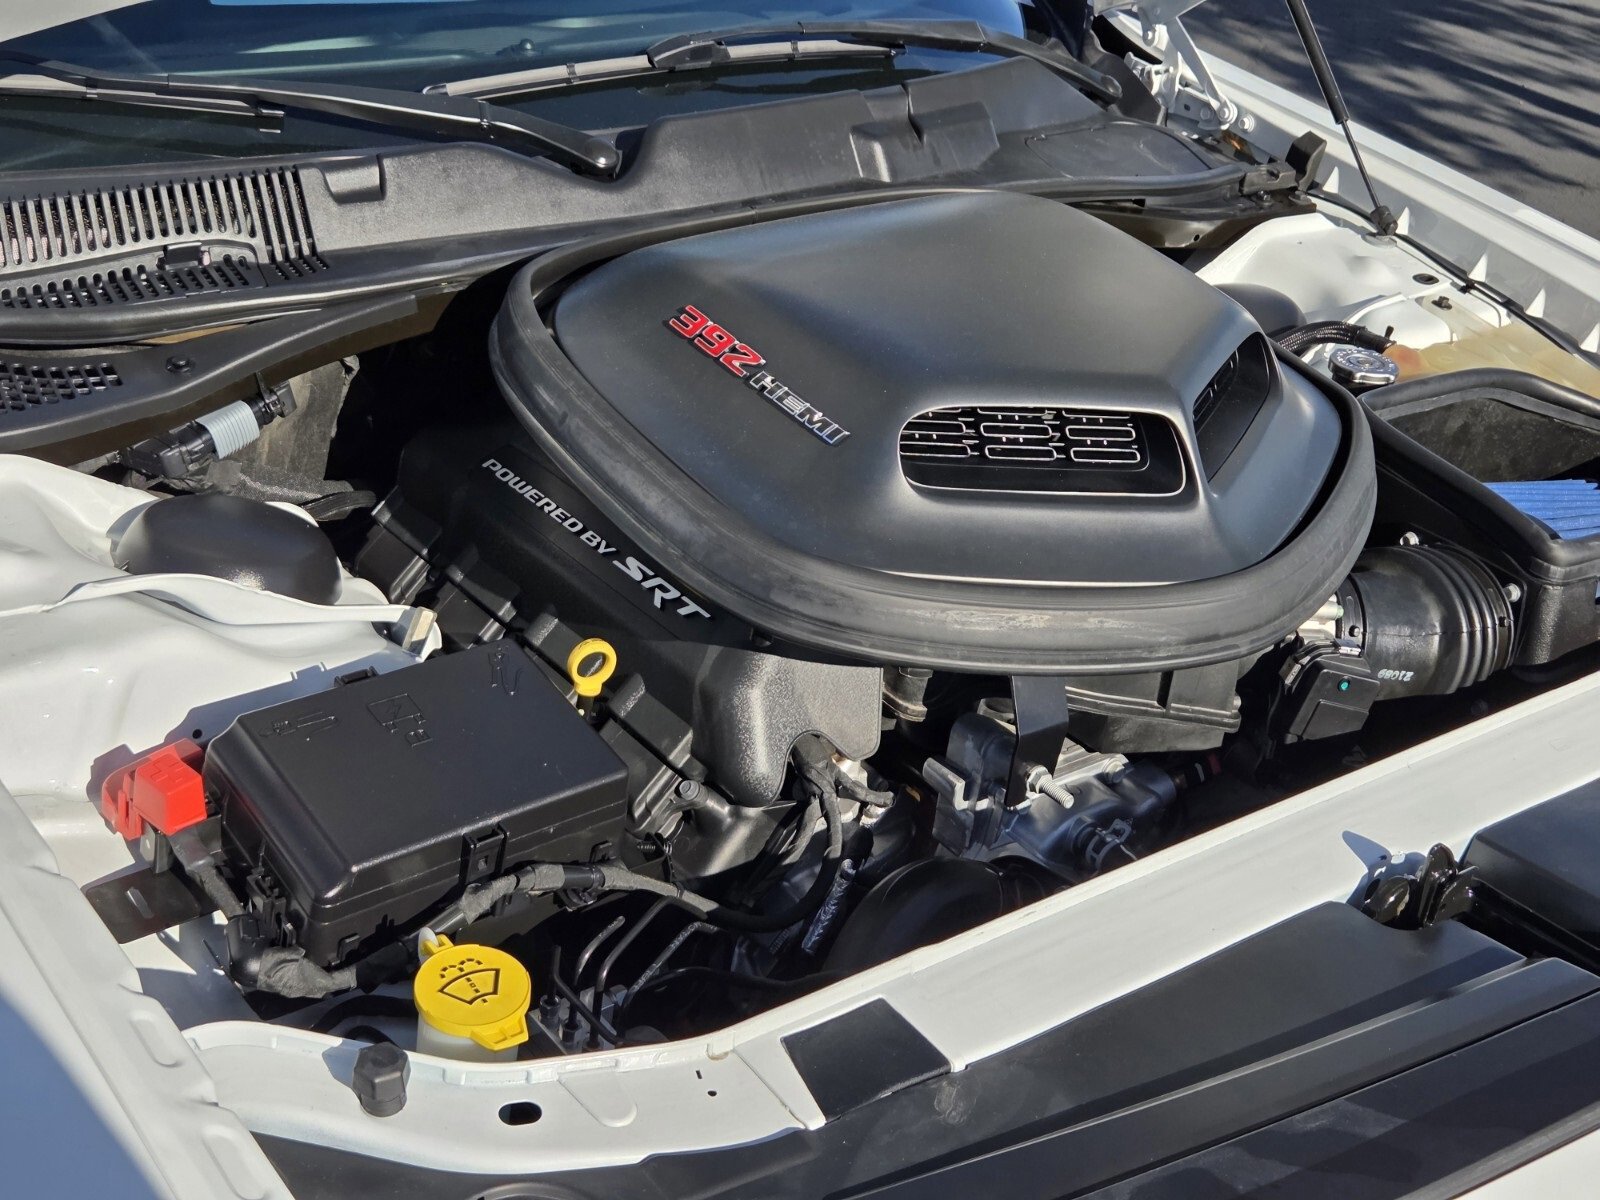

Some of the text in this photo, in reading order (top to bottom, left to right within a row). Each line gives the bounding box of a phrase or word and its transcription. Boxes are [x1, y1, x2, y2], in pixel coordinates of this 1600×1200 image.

[668, 304, 851, 444] 392 HEMI
[481, 458, 711, 620] POWERED BY SRT
